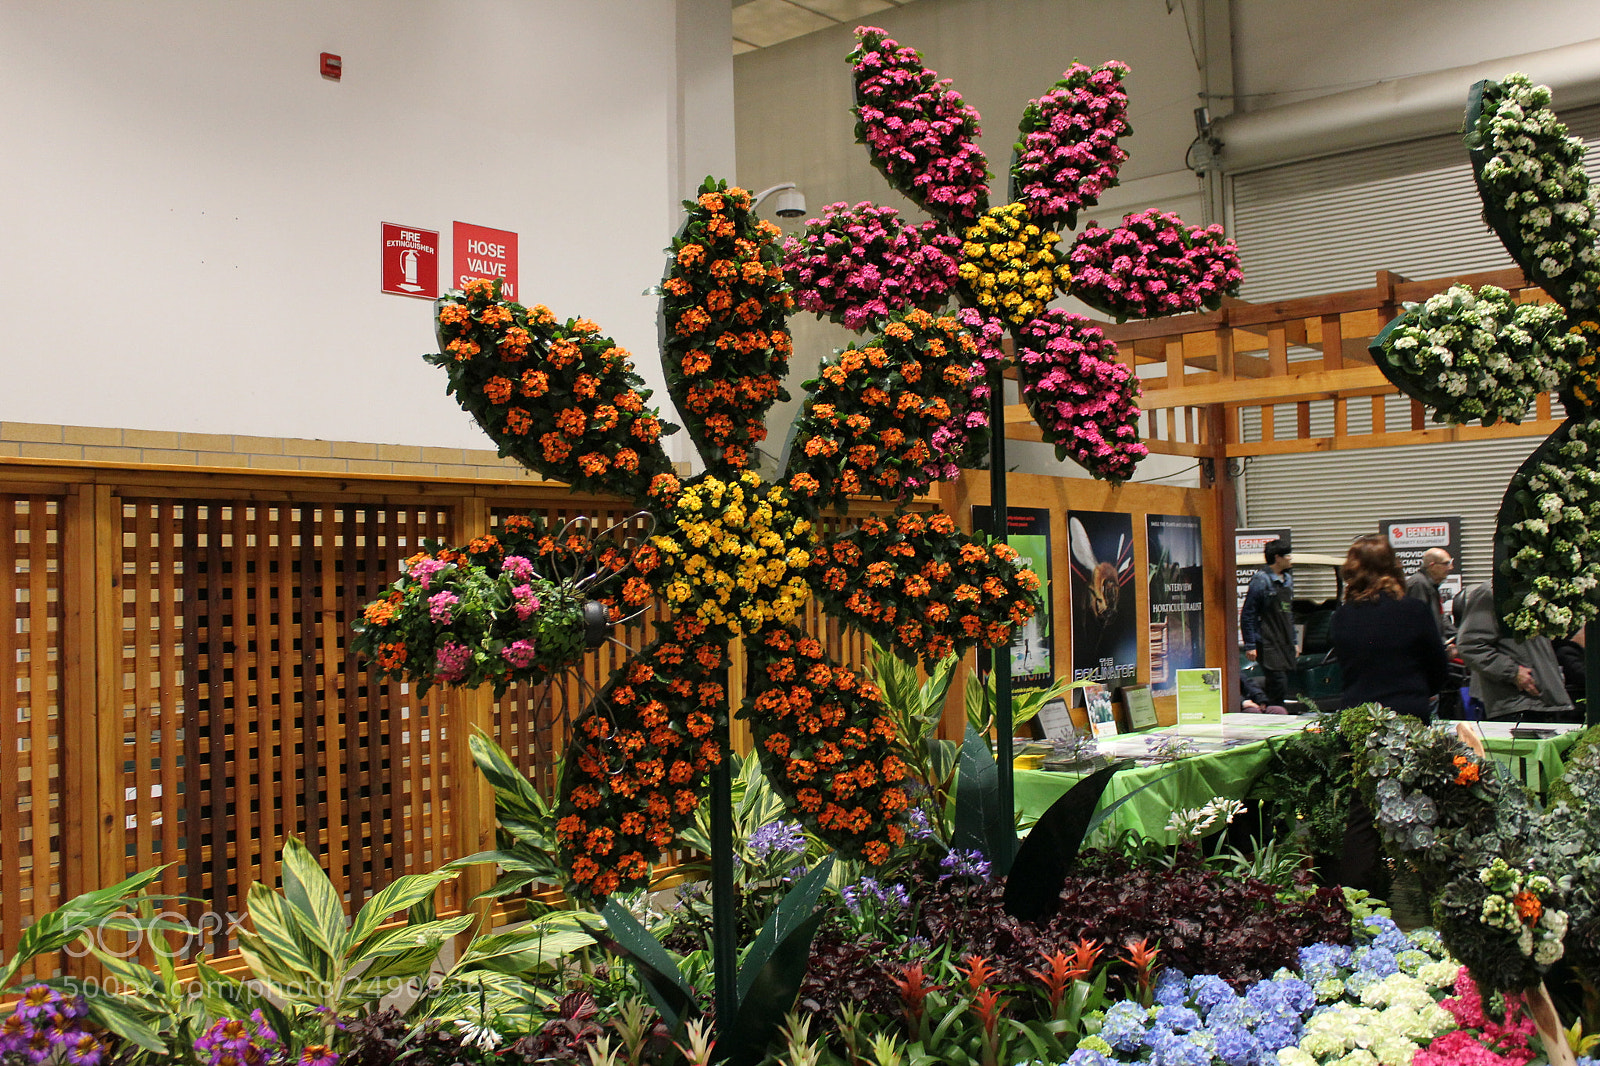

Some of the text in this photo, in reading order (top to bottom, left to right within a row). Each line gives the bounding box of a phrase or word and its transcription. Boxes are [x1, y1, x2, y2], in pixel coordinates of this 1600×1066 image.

[401, 230, 420, 243] FIRE
[386, 240, 434, 255] EXTINGUISHER
[468, 239, 506, 259] HOSE
[467, 258, 507, 278] VALVE
[1407, 526, 1445, 537] BENNETT
[1240, 539, 1271, 549] BENNE
[1164, 583, 1193, 592] INTERVIEW
[1099, 657, 1113, 666] THE
